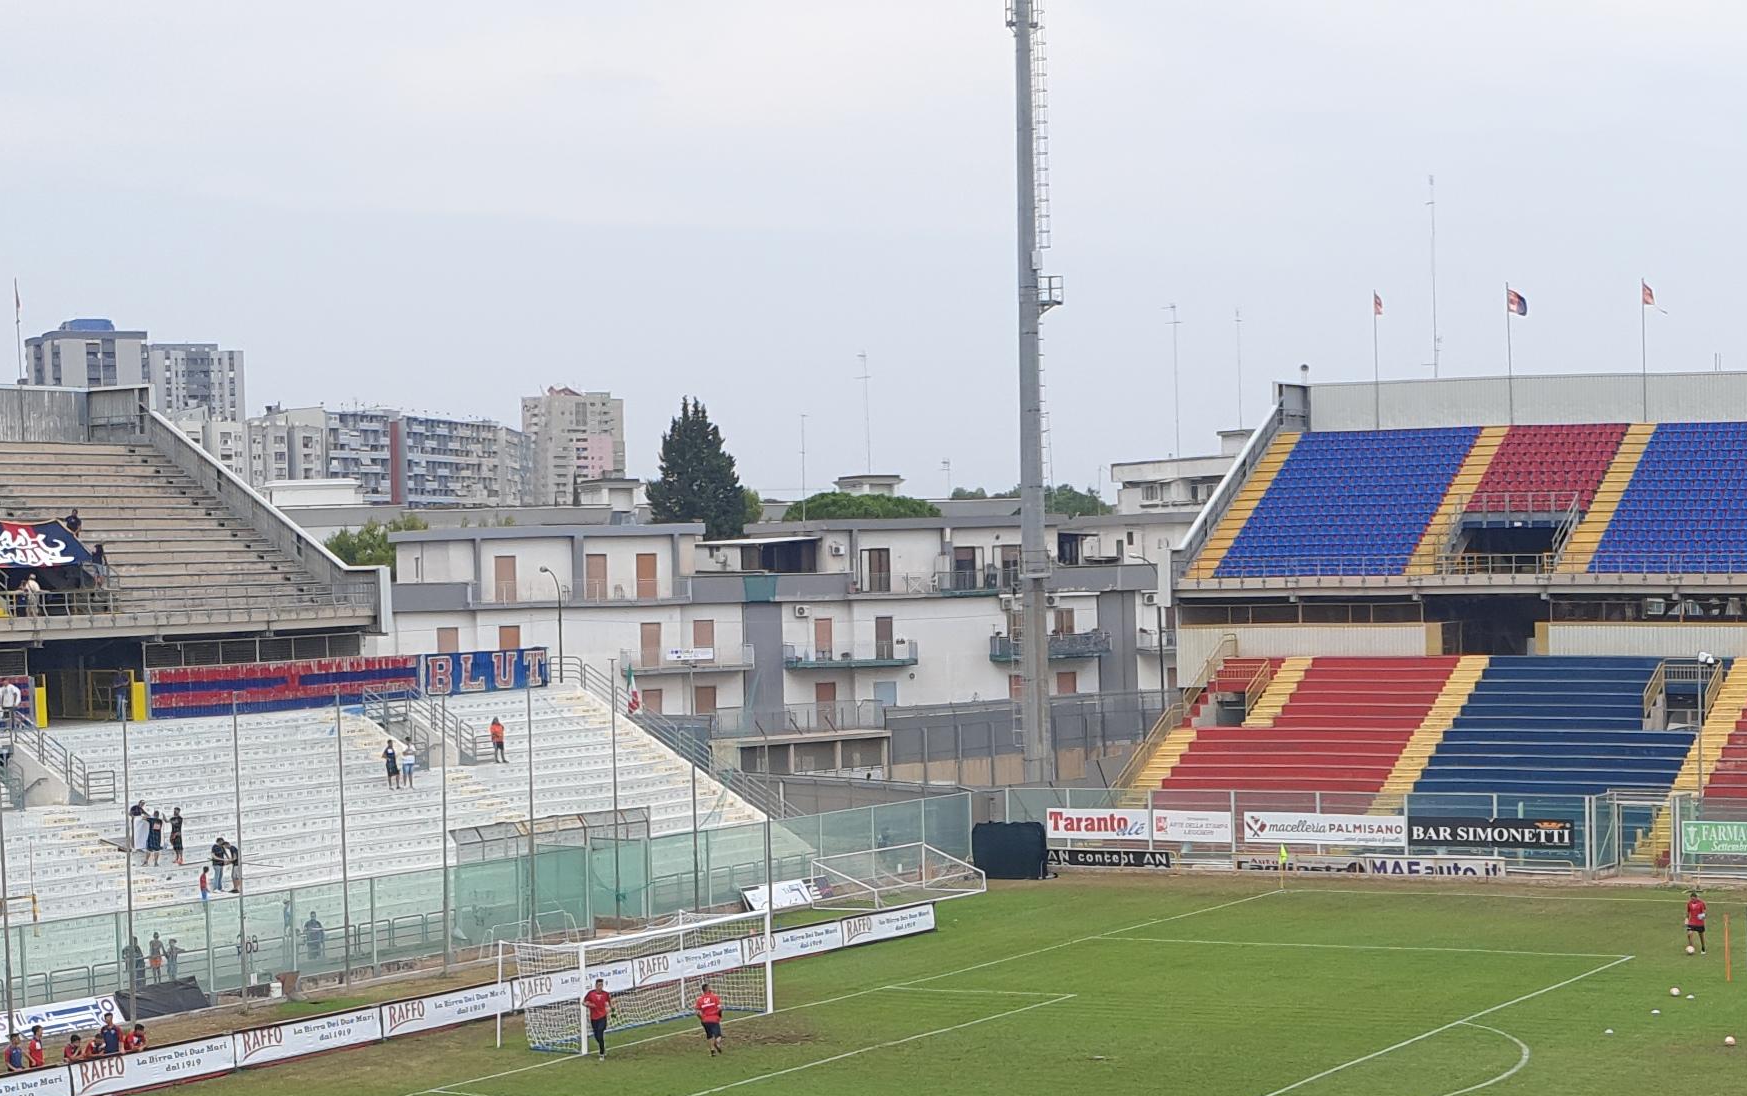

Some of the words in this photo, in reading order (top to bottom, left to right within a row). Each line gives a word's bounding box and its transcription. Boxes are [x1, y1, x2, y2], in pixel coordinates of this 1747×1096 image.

[427, 653, 547, 695] BLUT
[1049, 812, 1129, 833] Taranto
[1116, 821, 1146, 837] alé
[1268, 817, 1328, 834] macelleria
[1328, 824, 1403, 835] PALMISANO
[1412, 826, 1452, 841] BAR
[1456, 826, 1570, 843] SIMONETTI
[846, 916, 873, 939] RAFFO
[639, 954, 670, 980] RAFFO
[519, 975, 554, 1001] RAFFO
[388, 1000, 426, 1027] RAFFO
[242, 1026, 284, 1052] RAFFO
[79, 1055, 126, 1086] RAFFO
[4, 1082, 21, 1094] Dei
[21, 1079, 40, 1091] Due
[40, 1074, 63, 1088] Mari
